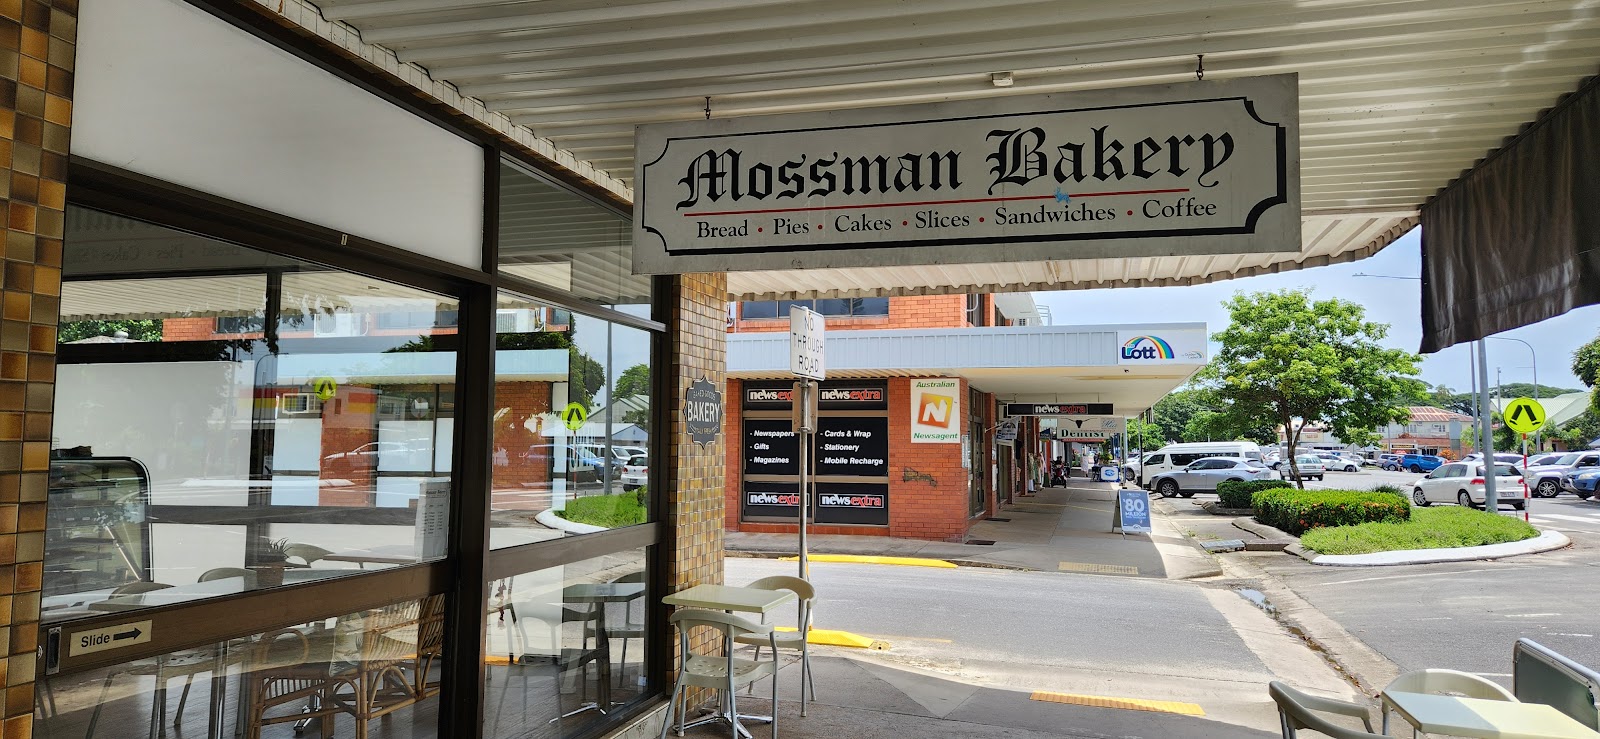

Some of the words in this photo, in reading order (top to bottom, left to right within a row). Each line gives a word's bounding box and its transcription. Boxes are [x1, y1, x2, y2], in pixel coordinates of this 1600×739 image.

[676, 148, 963, 211] Mossman
[985, 125, 1234, 195] Bakery
[697, 219, 748, 238] Bread
[773, 218, 810, 235] Pies
[834, 214, 892, 232] Cakes
[915, 210, 970, 229] Slices
[995, 203, 1116, 225] Sandwiches
[1142, 197, 1217, 218] Coffee
[804, 316, 814, 331] NO
[793, 332, 823, 354] THROUGH
[799, 354, 818, 372] ROAD
[687, 400, 720, 423] BAKERY
[922, 399, 947, 422] N
[754, 430, 795, 438] Newspapers
[853, 430, 872, 439] Wrap
[913, 432, 958, 440] Newsagent
[1061, 429, 1105, 438] Dentist
[824, 444, 860, 453] Stationery
[754, 456, 790, 465] Magazines
[824, 457, 848, 465] Mobile
[849, 457, 884, 467] Recharge
[81, 633, 110, 648] Slide
